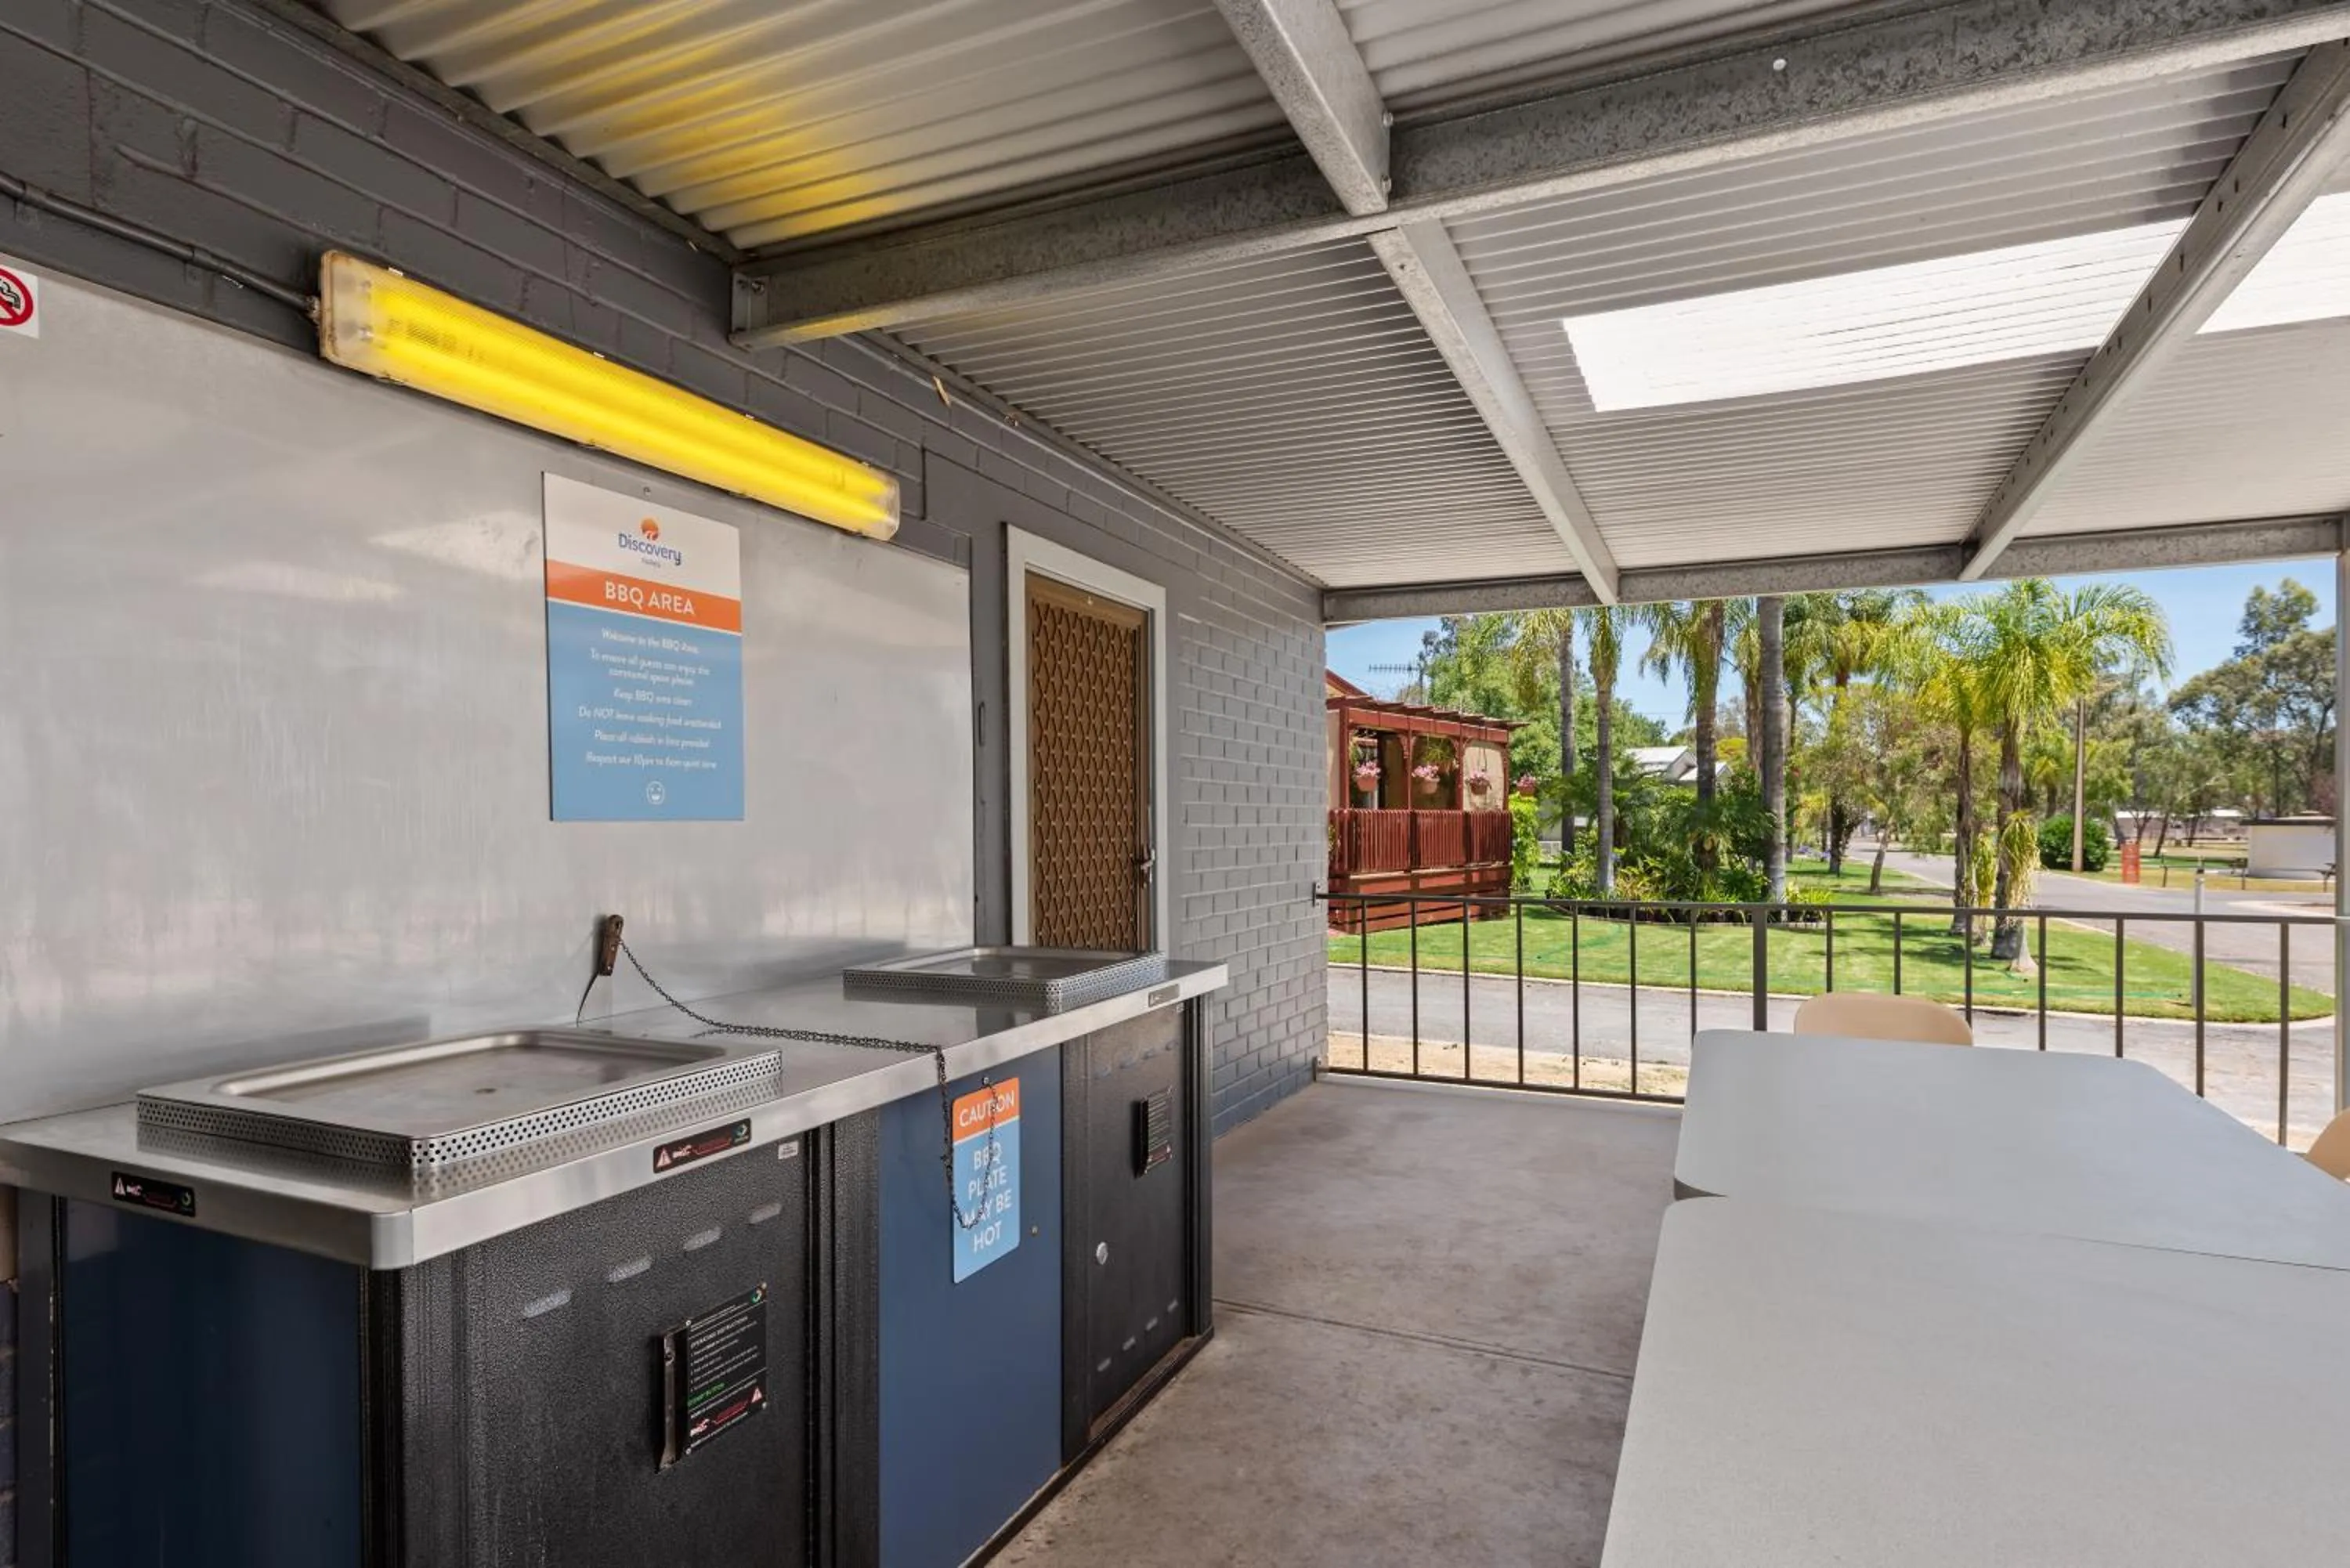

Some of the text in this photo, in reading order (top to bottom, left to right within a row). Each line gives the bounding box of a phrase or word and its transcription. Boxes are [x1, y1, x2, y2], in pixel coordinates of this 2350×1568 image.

[617, 533, 682, 565] Discovery
[606, 580, 696, 616] BBQ AREA
[662, 638, 680, 652] BBQ
[635, 688, 654, 703] BBQ
[579, 706, 591, 718] Do
[594, 707, 614, 719] NOT
[960, 1089, 1015, 1127] CAUTON
[973, 1141, 1003, 1171] BBQ
[968, 1165, 1007, 1201] PLATE
[996, 1189, 1013, 1213] BE
[973, 1221, 1003, 1253] HOT
